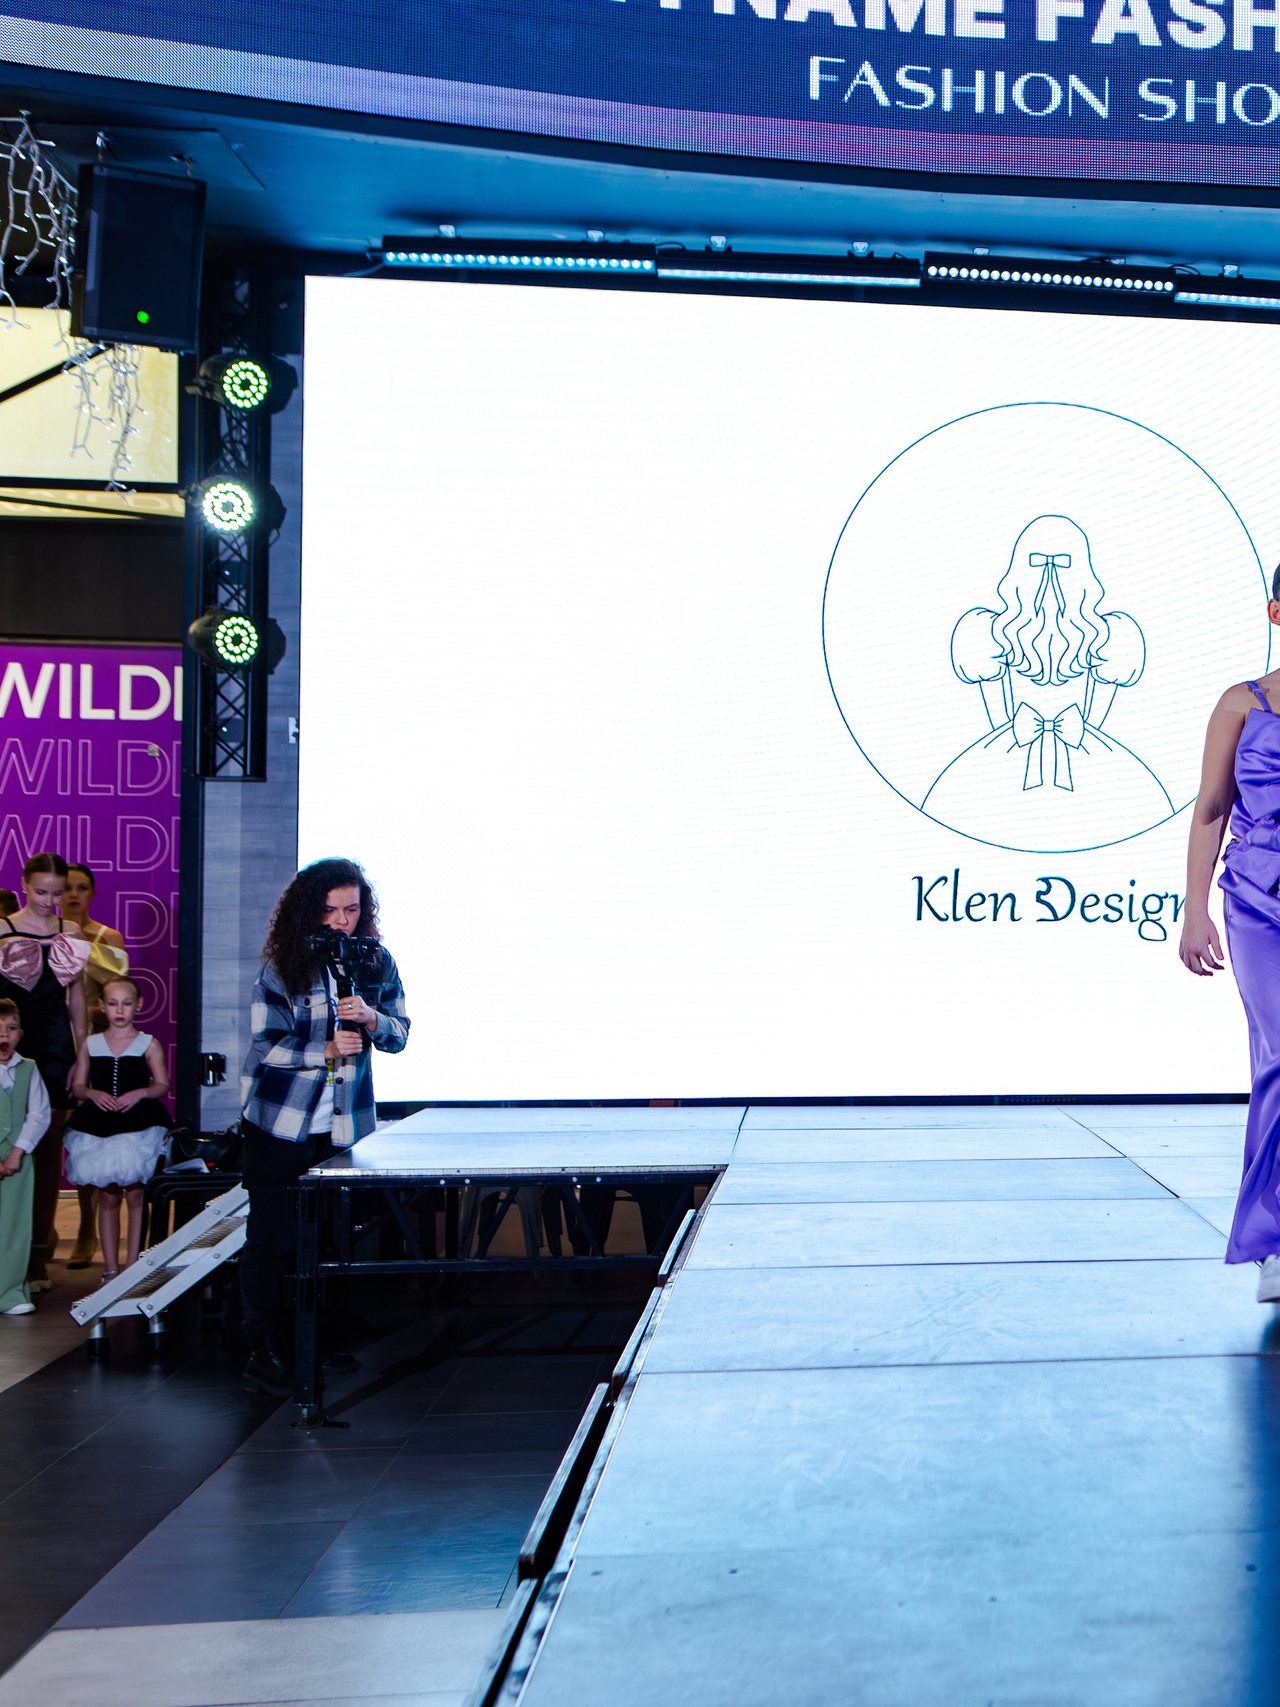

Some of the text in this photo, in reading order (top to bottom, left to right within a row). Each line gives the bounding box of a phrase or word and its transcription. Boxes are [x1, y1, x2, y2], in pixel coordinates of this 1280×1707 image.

[809, 55, 1109, 119] FASHION
[0, 661, 183, 721] WILD
[0, 738, 182, 797] WILD
[0, 814, 180, 873] WILD
[911, 867, 1022, 922] Klen
